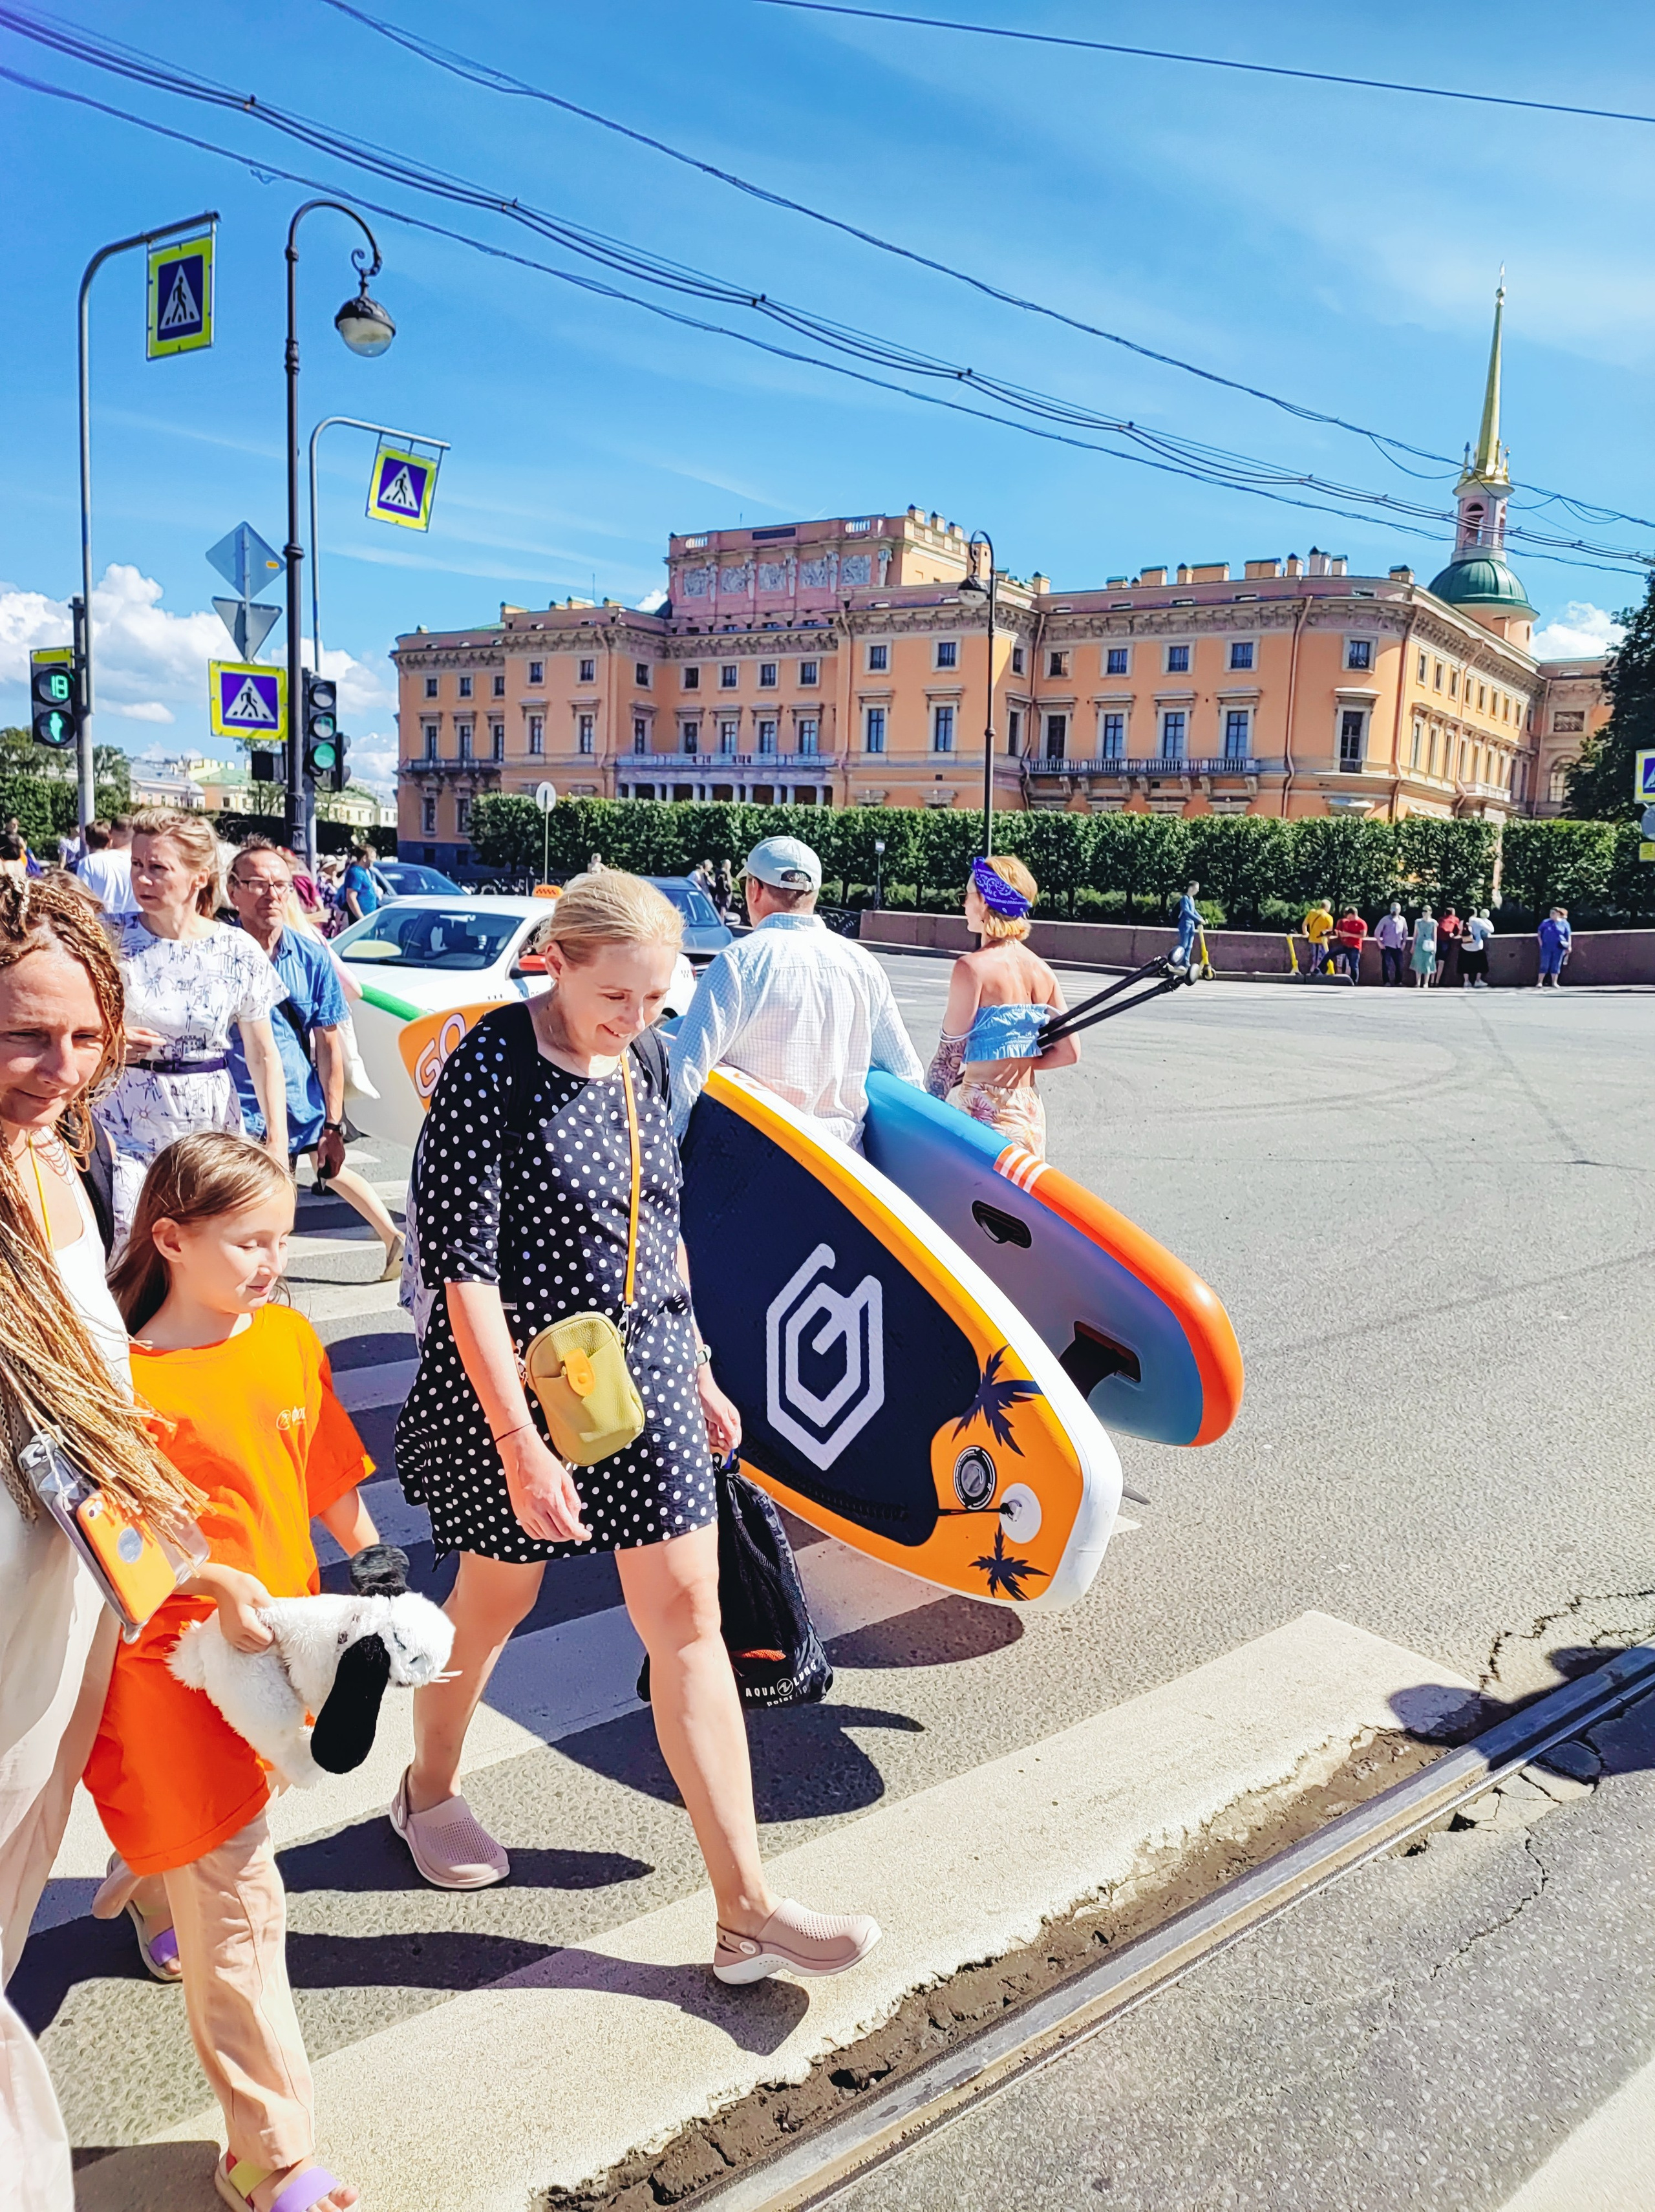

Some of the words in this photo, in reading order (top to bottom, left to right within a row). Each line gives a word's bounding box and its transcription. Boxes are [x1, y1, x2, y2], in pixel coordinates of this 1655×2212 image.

[51, 675, 68, 699] 18
[745, 1686, 776, 1697] AQUA
[793, 1659, 817, 1686] LUNG
[767, 1694, 793, 1707] polar
